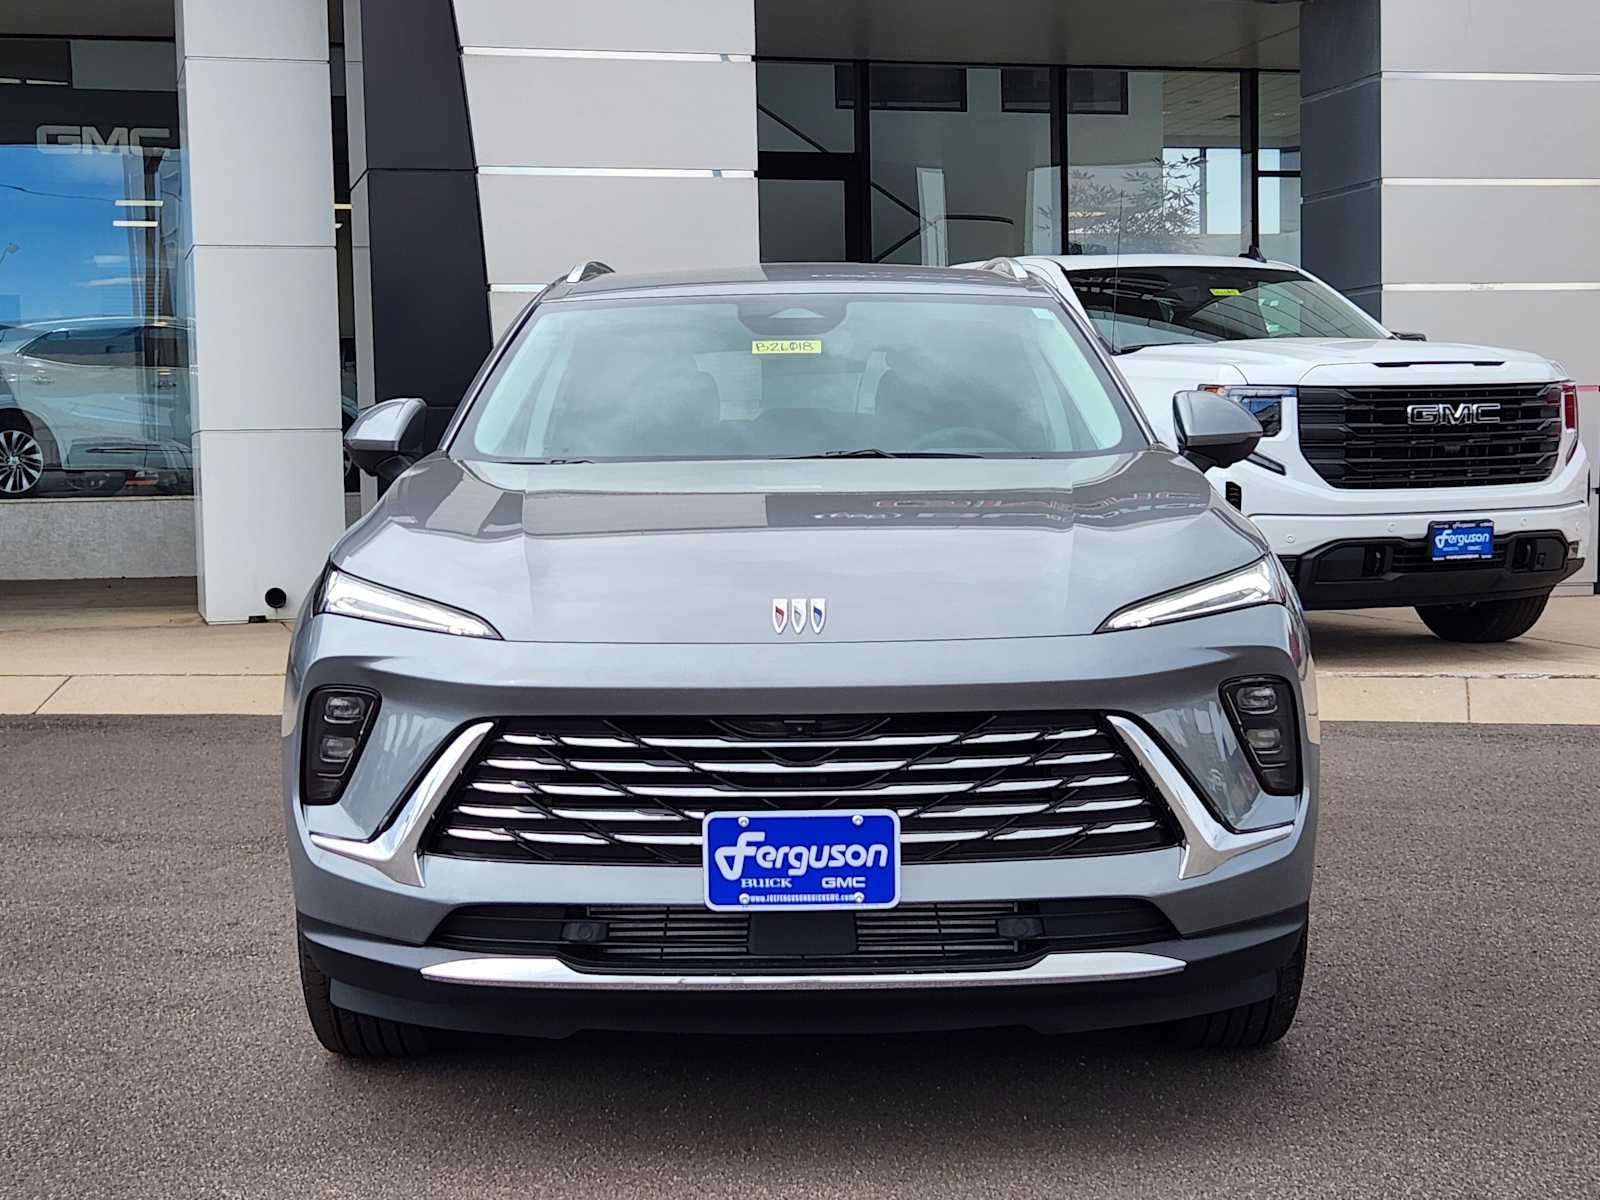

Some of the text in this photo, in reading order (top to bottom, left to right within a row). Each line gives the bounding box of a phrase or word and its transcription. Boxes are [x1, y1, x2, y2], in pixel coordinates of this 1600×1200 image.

[36, 125, 170, 157] GMC
[1407, 403, 1500, 425] GMC
[1435, 529, 1490, 549] Ferguson
[714, 831, 888, 881] Ferguson
[741, 877, 866, 889] BUICK GMC
